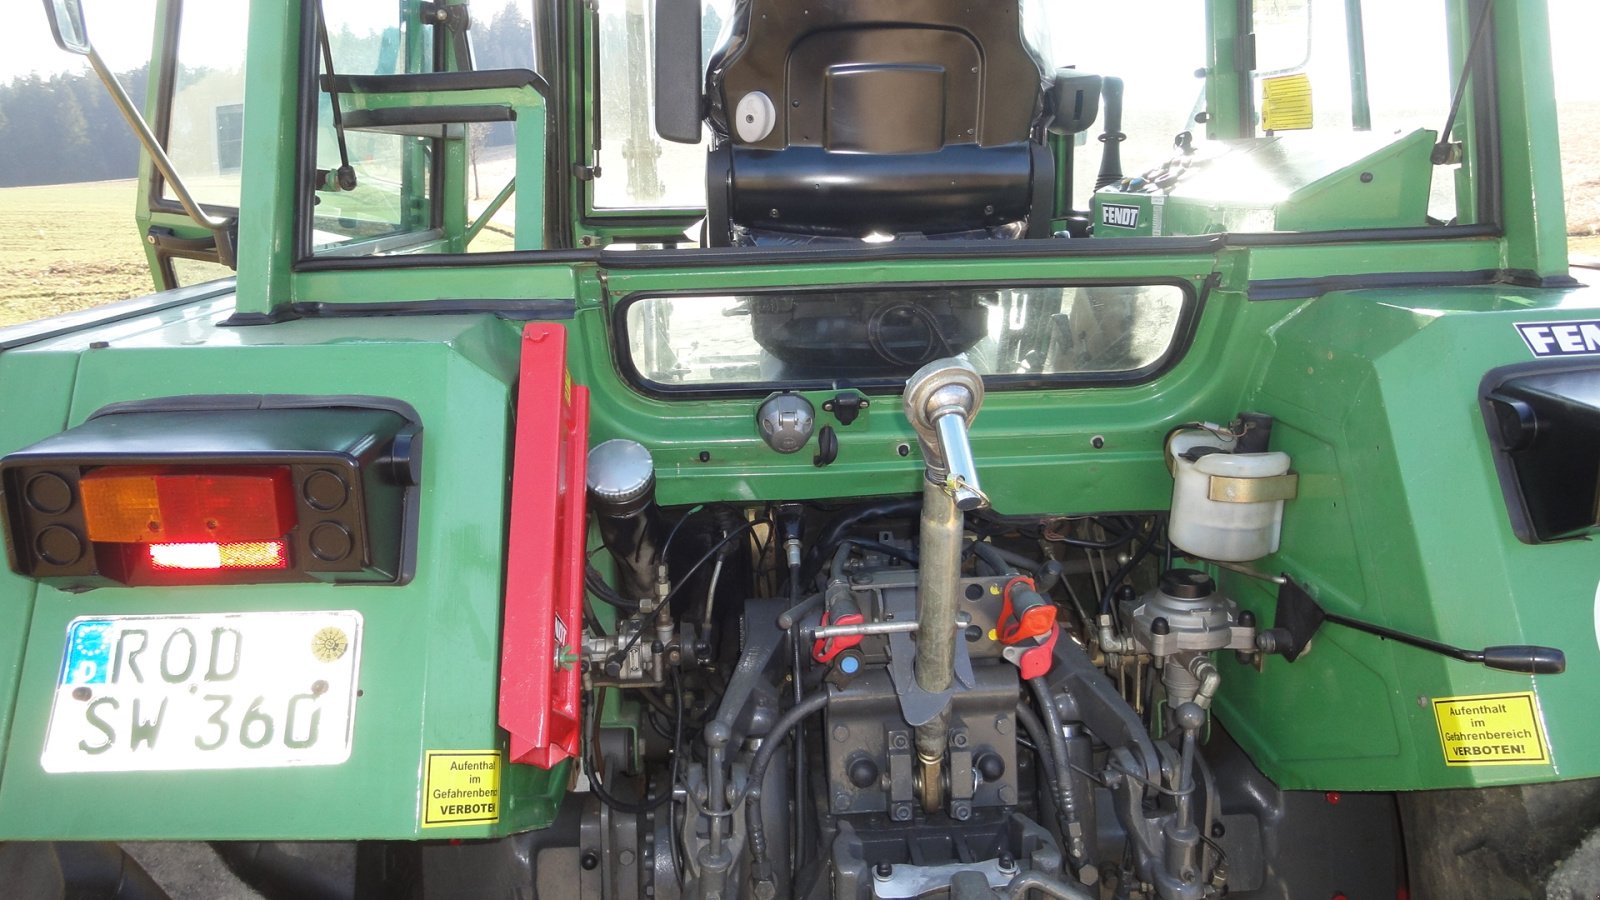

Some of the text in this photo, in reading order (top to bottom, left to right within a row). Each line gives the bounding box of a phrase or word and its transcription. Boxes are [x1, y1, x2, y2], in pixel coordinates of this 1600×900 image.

[1102, 206, 1138, 226] FENDT
[111, 627, 243, 684] ROD
[73, 660, 97, 684] D
[1450, 704, 1507, 716] Aufenthalt
[78, 693, 322, 755] SW 360
[1471, 718, 1486, 727] im
[1445, 729, 1532, 742] Gefahrenbereich
[1453, 744, 1526, 756] VERBOTEN!
[450, 761, 496, 771] Aufenthal
[469, 775, 481, 784] im
